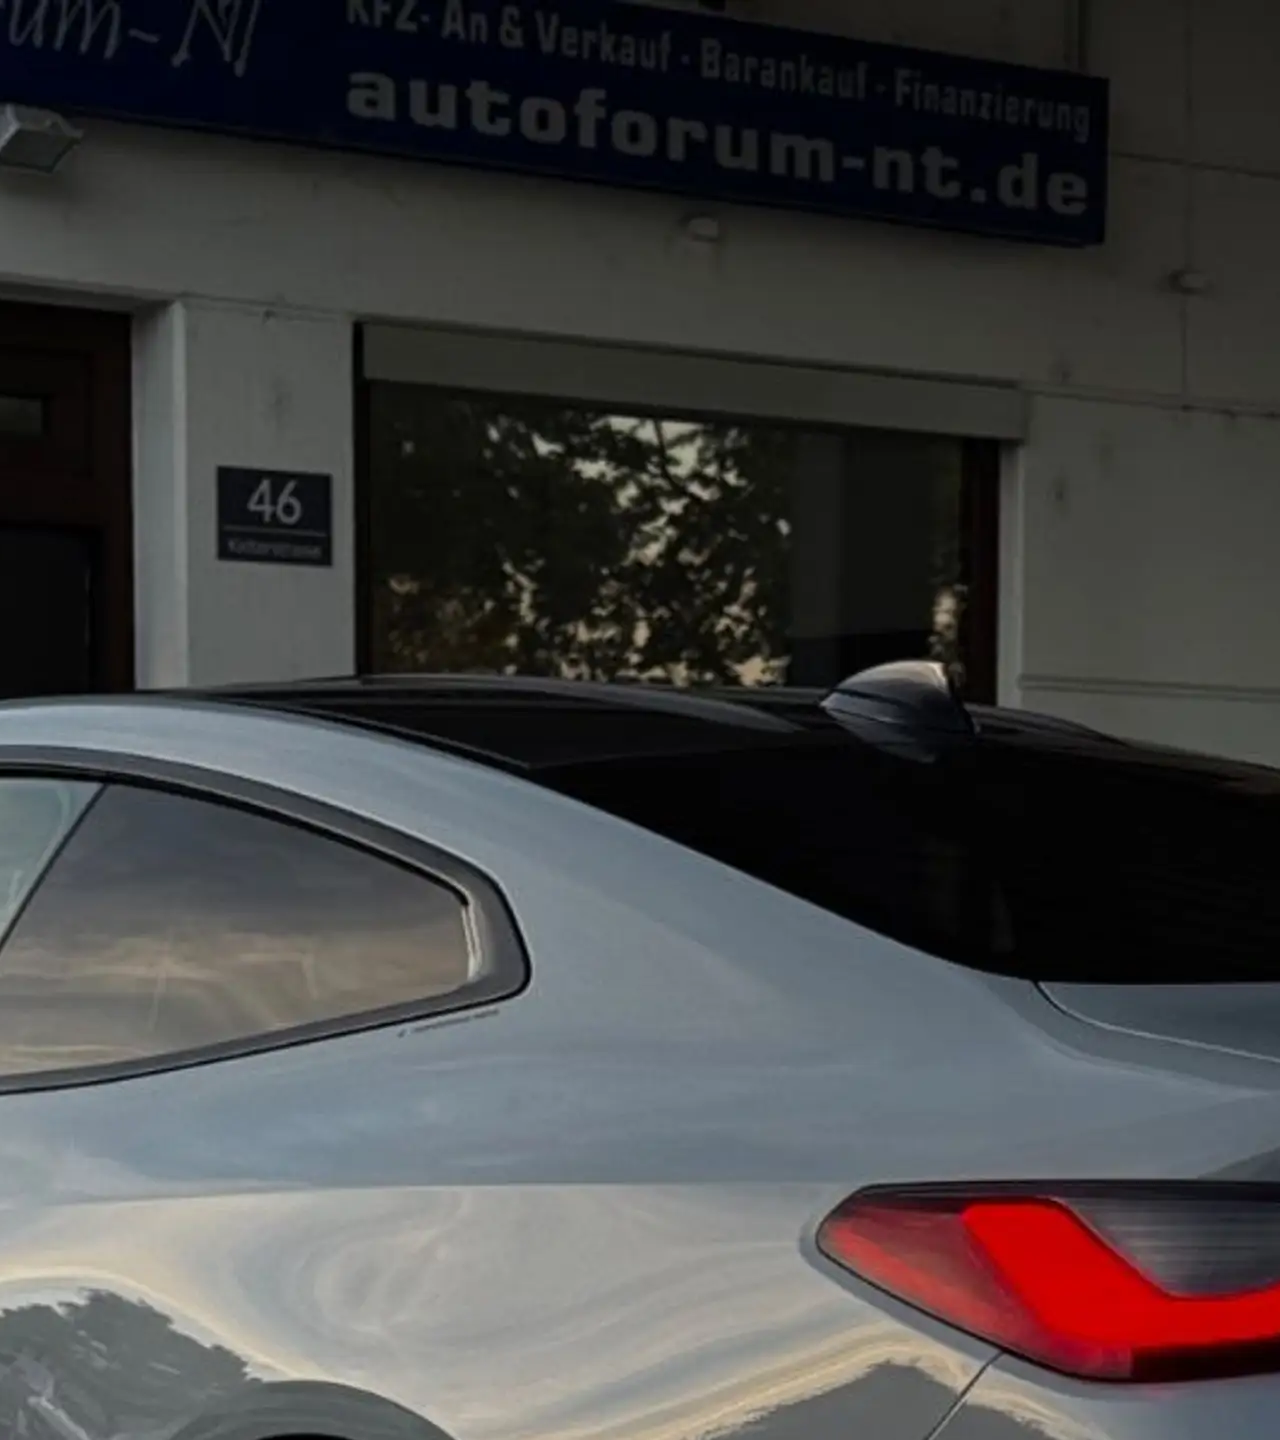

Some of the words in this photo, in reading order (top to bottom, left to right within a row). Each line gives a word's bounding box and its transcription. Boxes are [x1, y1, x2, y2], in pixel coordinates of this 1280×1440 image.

[344, 68, 1088, 216] autoforum-nt.de
[439, 0, 488, 44] An
[498, 5, 524, 49] &
[533, 9, 673, 74] Verkauf
[699, 37, 871, 101] Barankauf
[894, 68, 1090, 145] Finanzierung
[246, 478, 303, 526] 46
